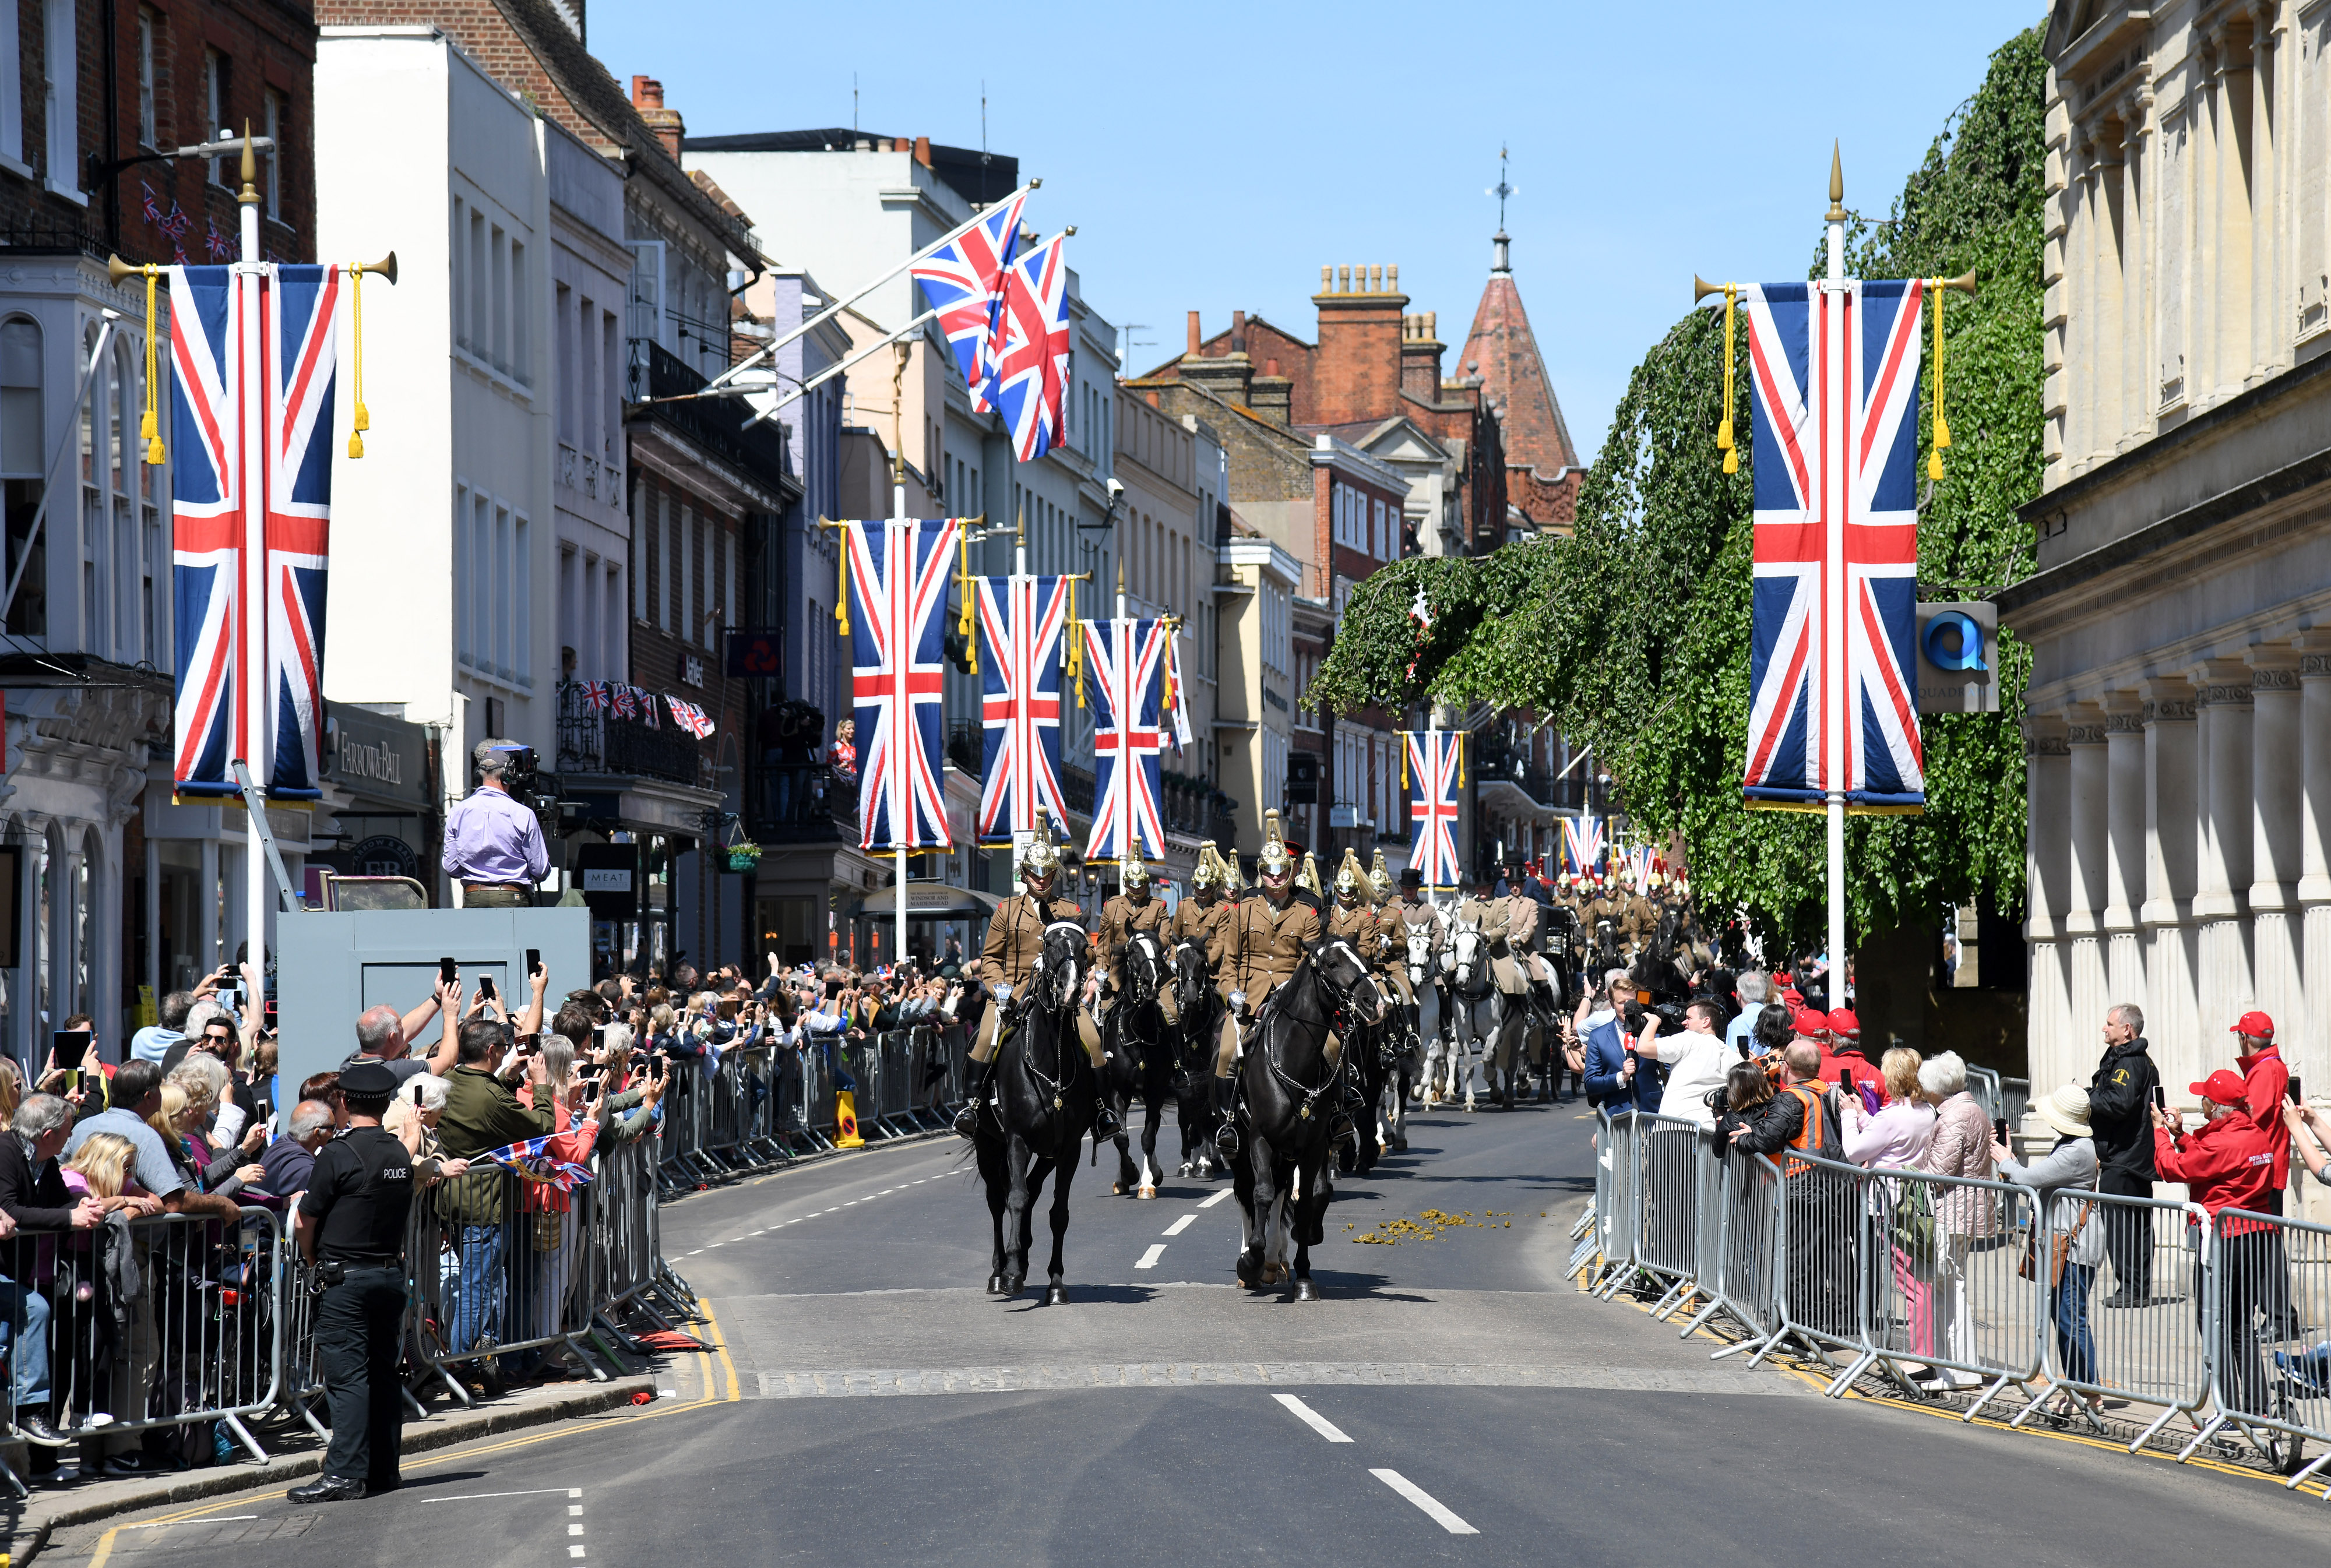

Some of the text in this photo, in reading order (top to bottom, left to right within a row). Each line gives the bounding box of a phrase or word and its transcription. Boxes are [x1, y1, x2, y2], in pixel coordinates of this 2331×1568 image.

[1052, 818, 1061, 827] A
[397, 845, 414, 867] BALL
[591, 873, 624, 882] MEAT
[383, 1168, 406, 1179] POLICE
